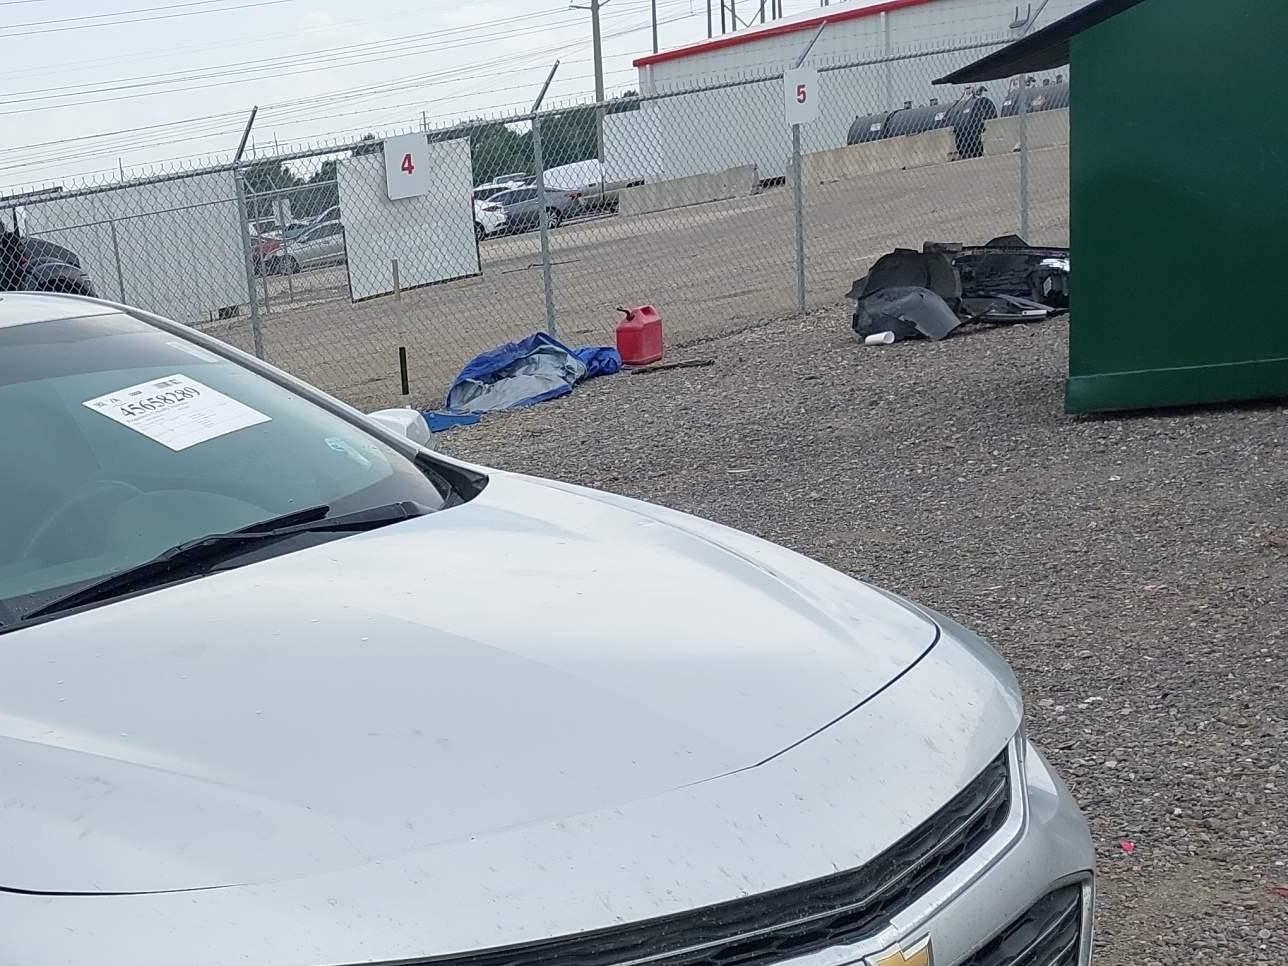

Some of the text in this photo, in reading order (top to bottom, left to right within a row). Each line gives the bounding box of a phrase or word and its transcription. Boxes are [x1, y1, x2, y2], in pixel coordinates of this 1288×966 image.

[796, 84, 807, 104] 5
[401, 153, 415, 175] 4
[119, 386, 201, 418] 45658289
